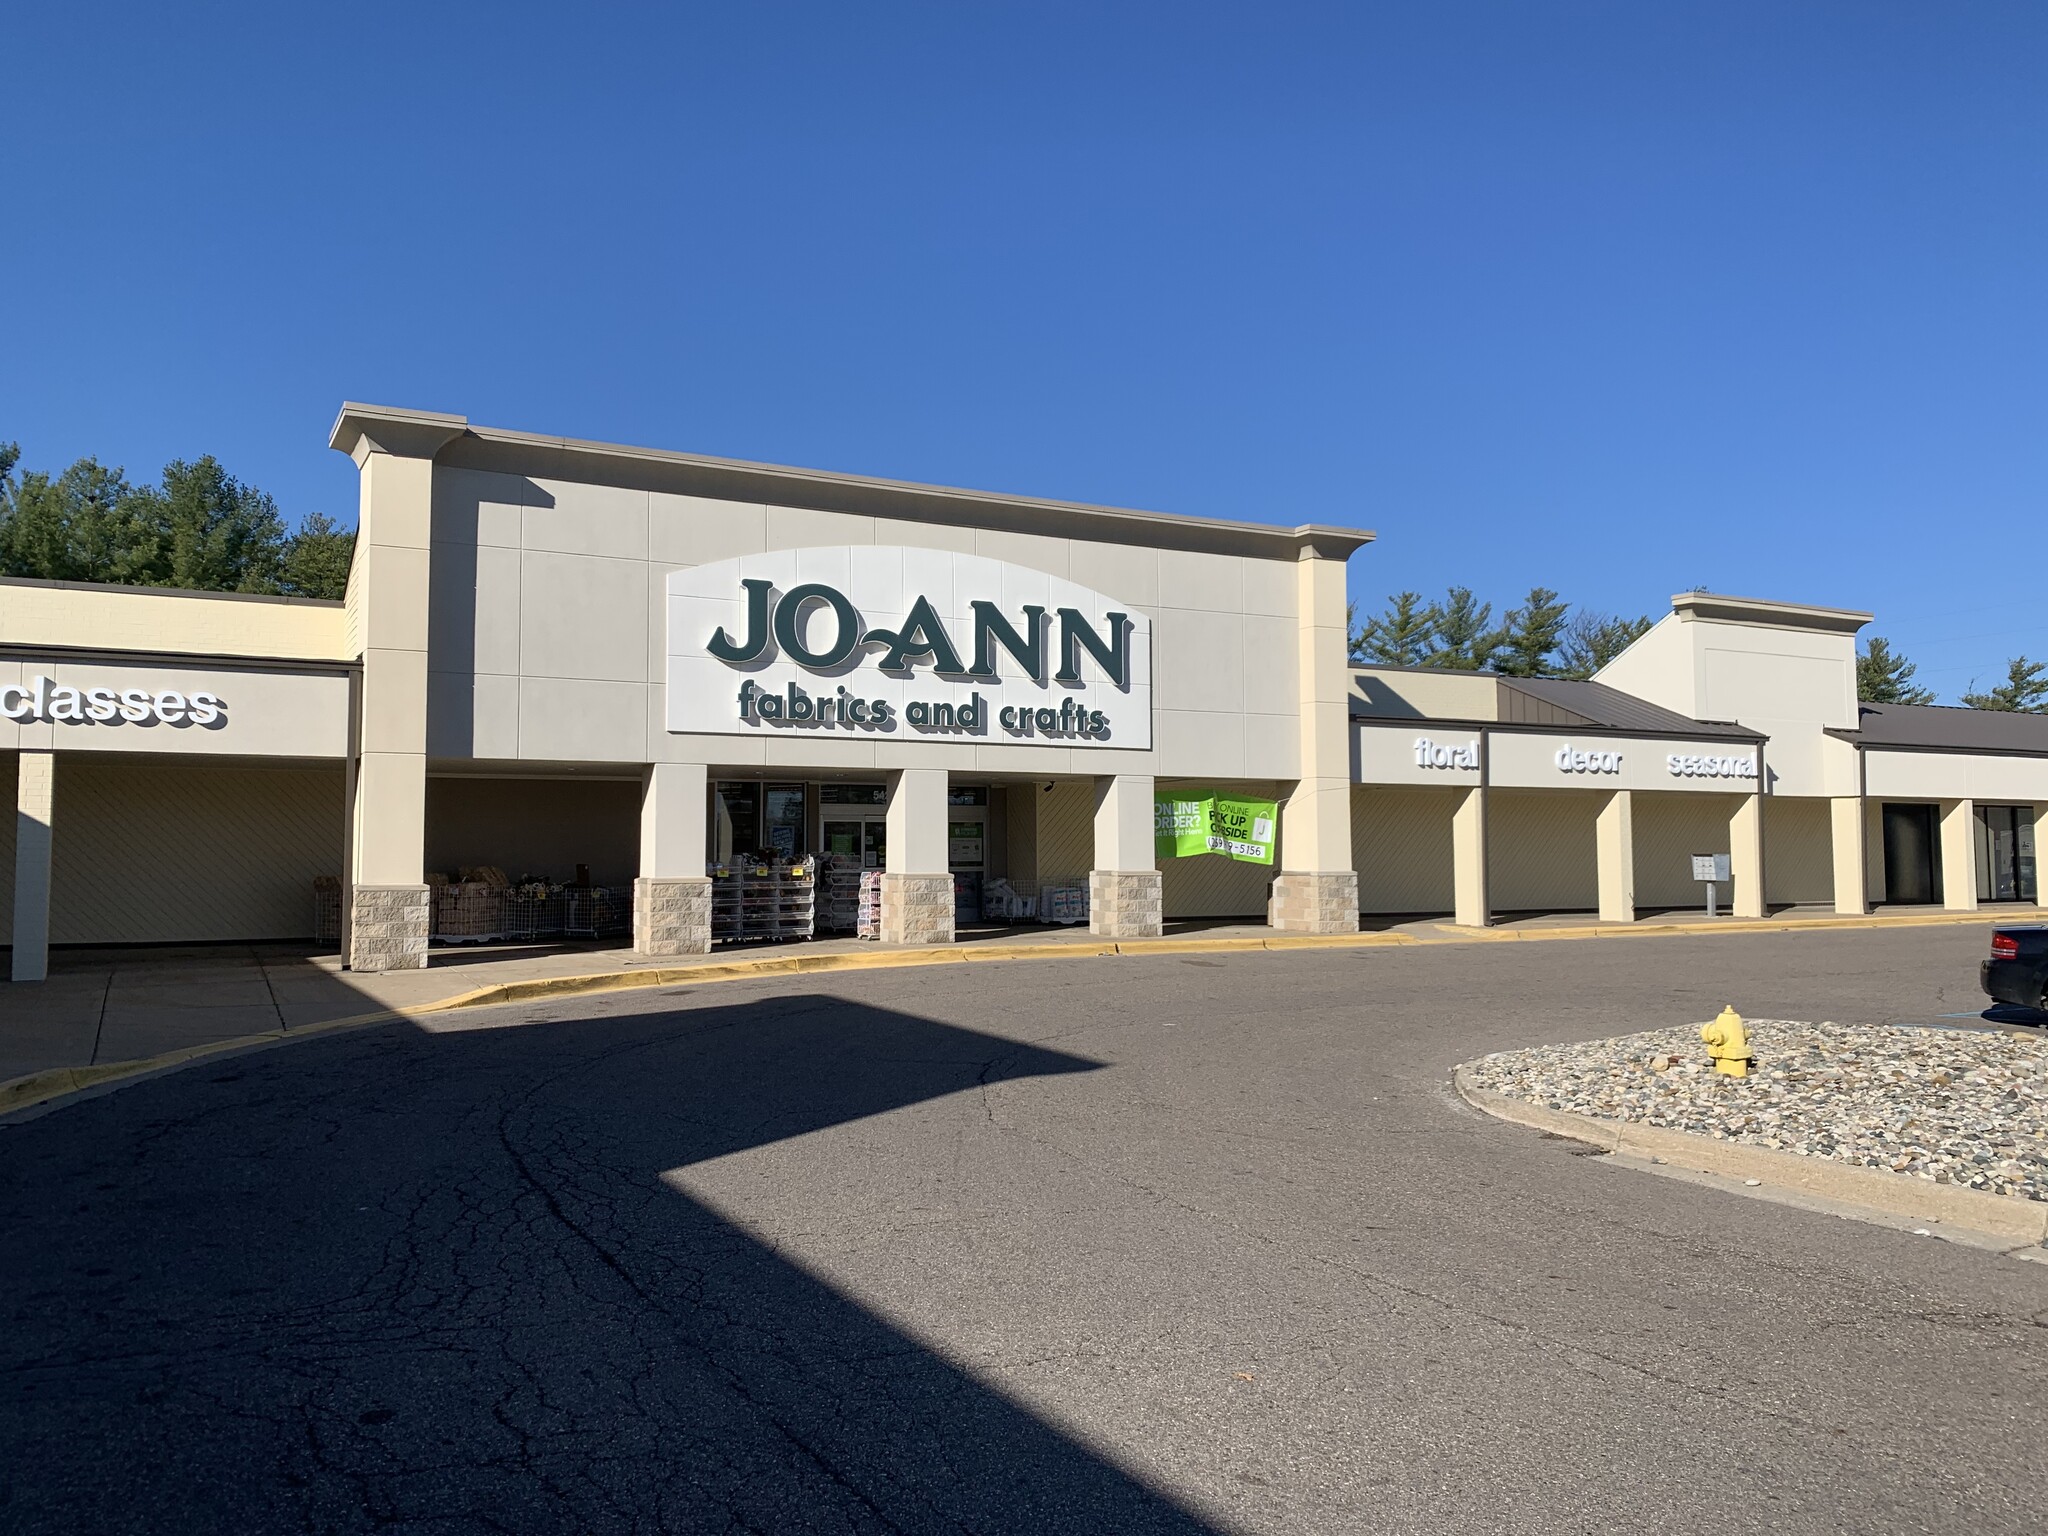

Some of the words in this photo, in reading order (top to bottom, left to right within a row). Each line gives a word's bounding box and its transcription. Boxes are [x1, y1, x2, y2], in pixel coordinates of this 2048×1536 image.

[0, 675, 219, 725] classes
[738, 679, 888, 725] fabrics
[906, 692, 981, 728] and
[998, 697, 1105, 733] crafts
[1414, 737, 1479, 767] floral
[1555, 743, 1622, 771] decor
[1666, 752, 1758, 776] seasonal
[1154, 802, 1200, 816] ONLINE
[1208, 810, 1228, 824] PCK
[1230, 815, 1246, 826] UP
[1219, 803, 1249, 816] ONLINE
[1154, 815, 1201, 829] ORDER?
